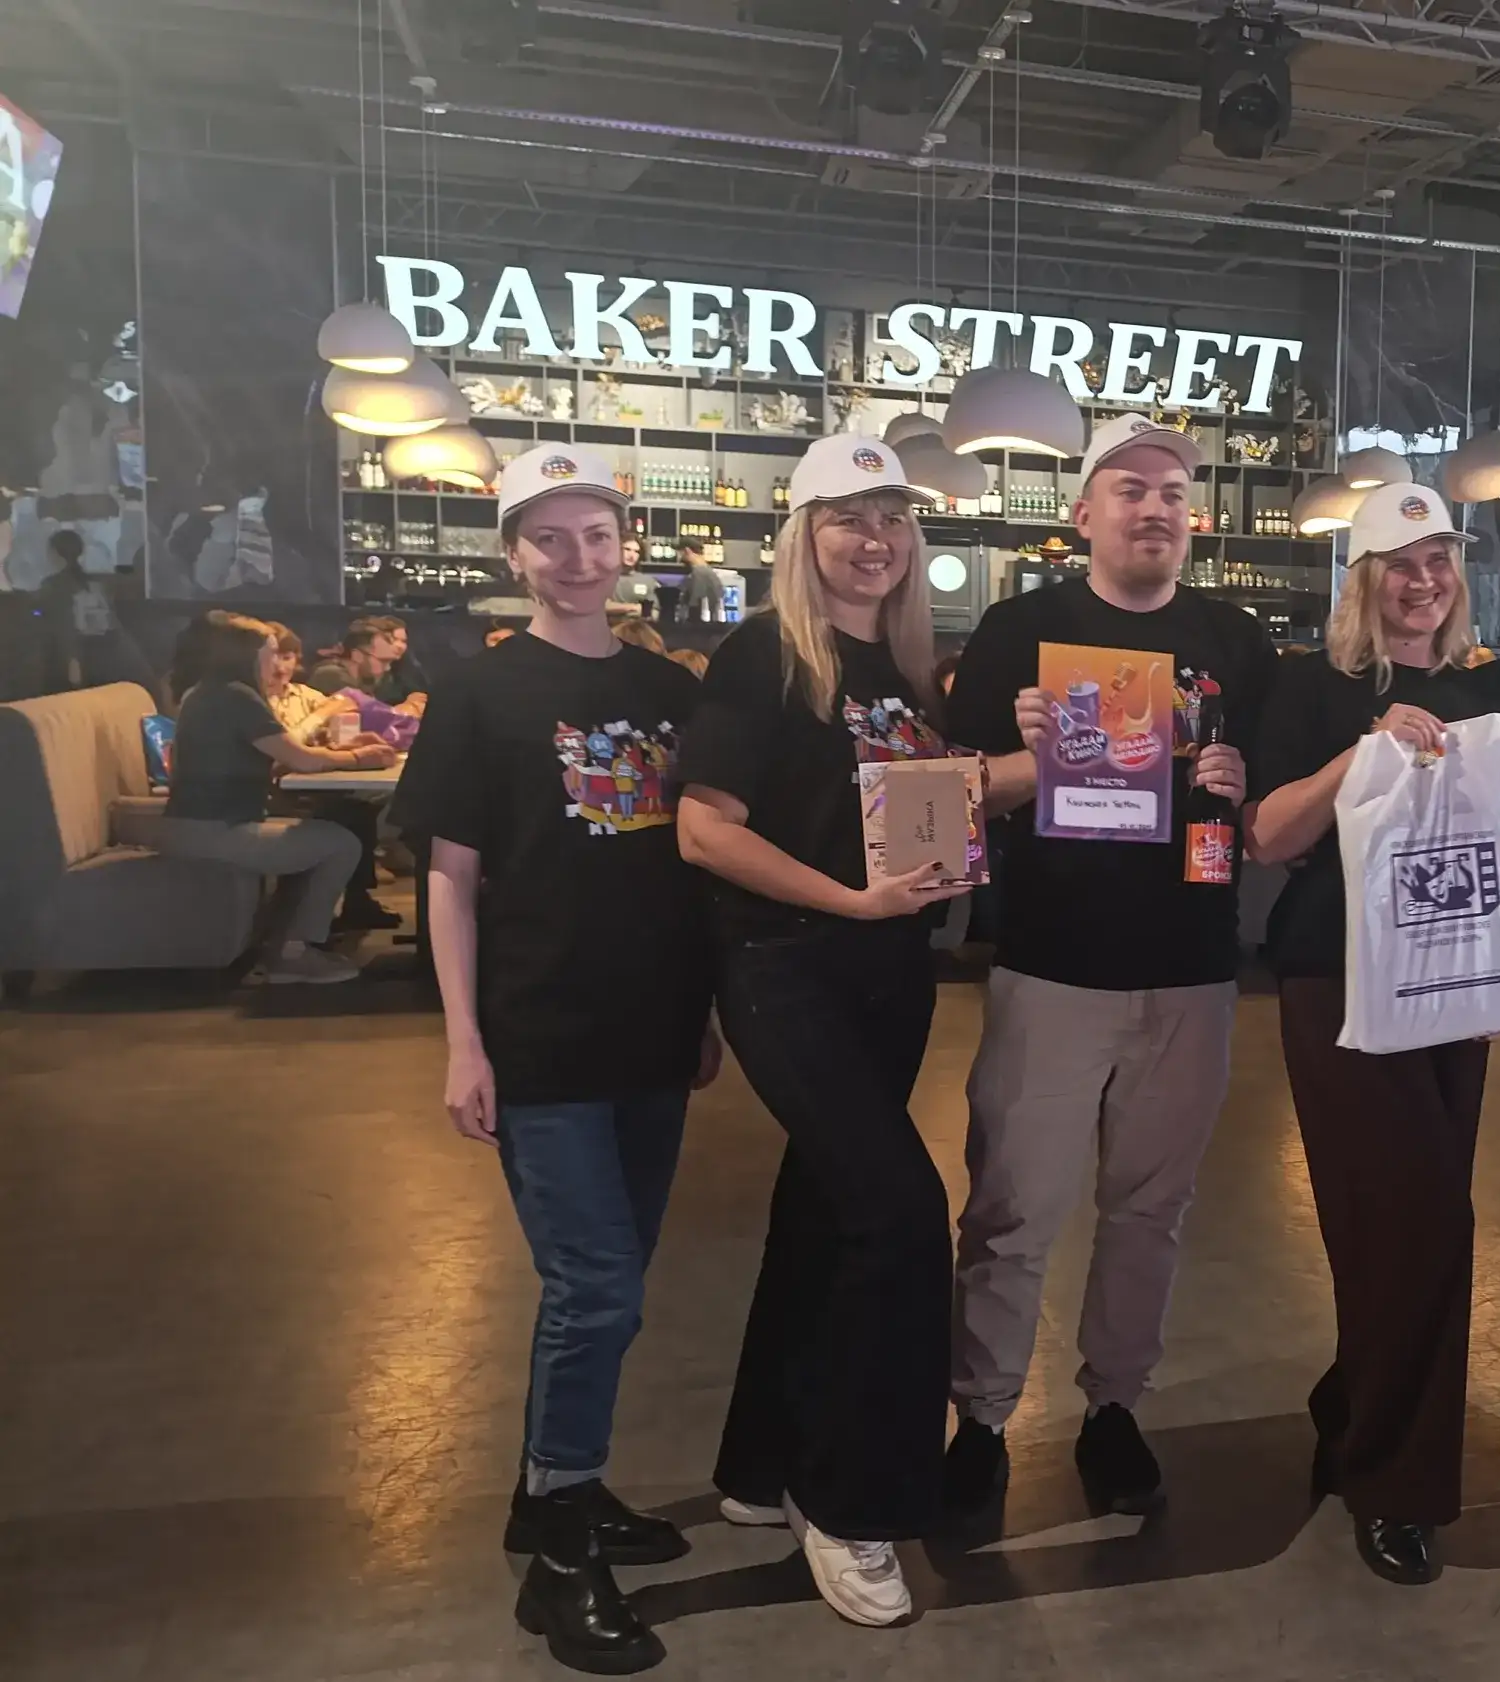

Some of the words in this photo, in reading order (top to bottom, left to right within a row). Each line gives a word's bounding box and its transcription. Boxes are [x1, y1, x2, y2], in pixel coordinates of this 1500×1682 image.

[375, 255, 824, 377] BAKER
[883, 303, 1302, 413] STREET
[925, 800, 936, 843] МУЗЫКА
